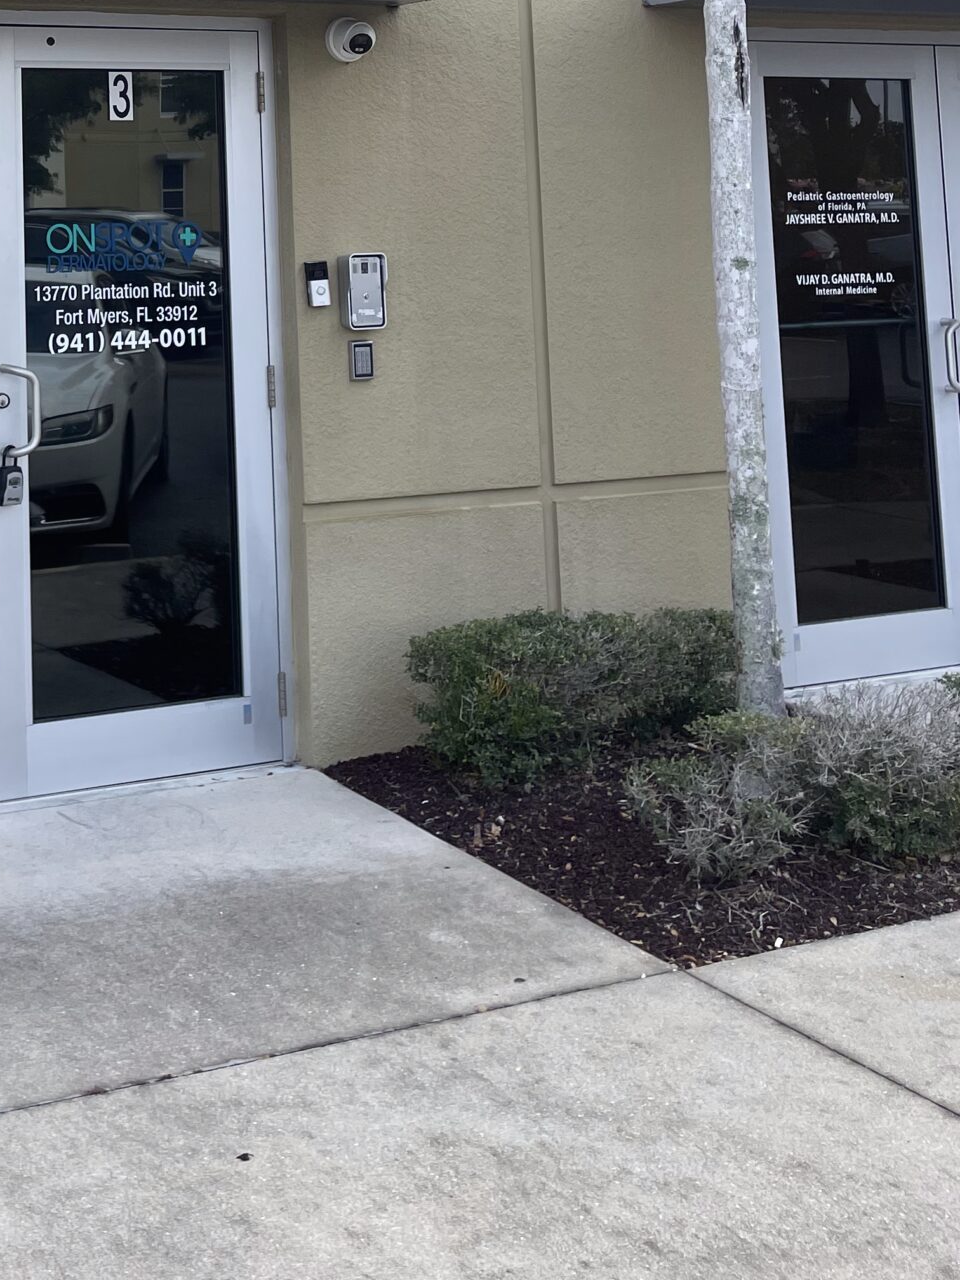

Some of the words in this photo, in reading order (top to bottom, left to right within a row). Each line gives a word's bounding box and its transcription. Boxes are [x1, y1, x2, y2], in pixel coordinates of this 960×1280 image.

[113, 74, 130, 118] 3
[787, 191, 823, 201] Pediatric
[826, 190, 894, 202] Gastroenterology
[818, 202, 826, 211] of
[828, 202, 855, 211] Florida,
[856, 202, 867, 210] PA
[785, 213, 827, 225] JAYSHREE
[827, 213, 836, 224] V.
[835, 213, 880, 225] GANATRA,
[880, 212, 900, 223] M.D.
[46, 221, 168, 253] ONSPOT
[46, 251, 167, 273] DERMATOLOGY
[796, 274, 821, 285] VIJAY
[822, 274, 831, 285] D.
[831, 273, 875, 285] GANATRA,
[876, 272, 895, 283] M.D.
[34, 285, 77, 301] 13770
[81, 284, 149, 300] Plantation
[153, 283, 175, 298] Rd.
[179, 282, 205, 297] Unit
[208, 281, 217, 296] 3
[815, 286, 844, 296] Internal
[846, 286, 878, 295] Medicine
[55, 310, 83, 325] Fort
[88, 309, 133, 327] Myers,
[136, 307, 152, 322] FL
[156, 305, 198, 321] 33912
[48, 331, 104, 355] (941)
[111, 327, 207, 350] 444-0011
